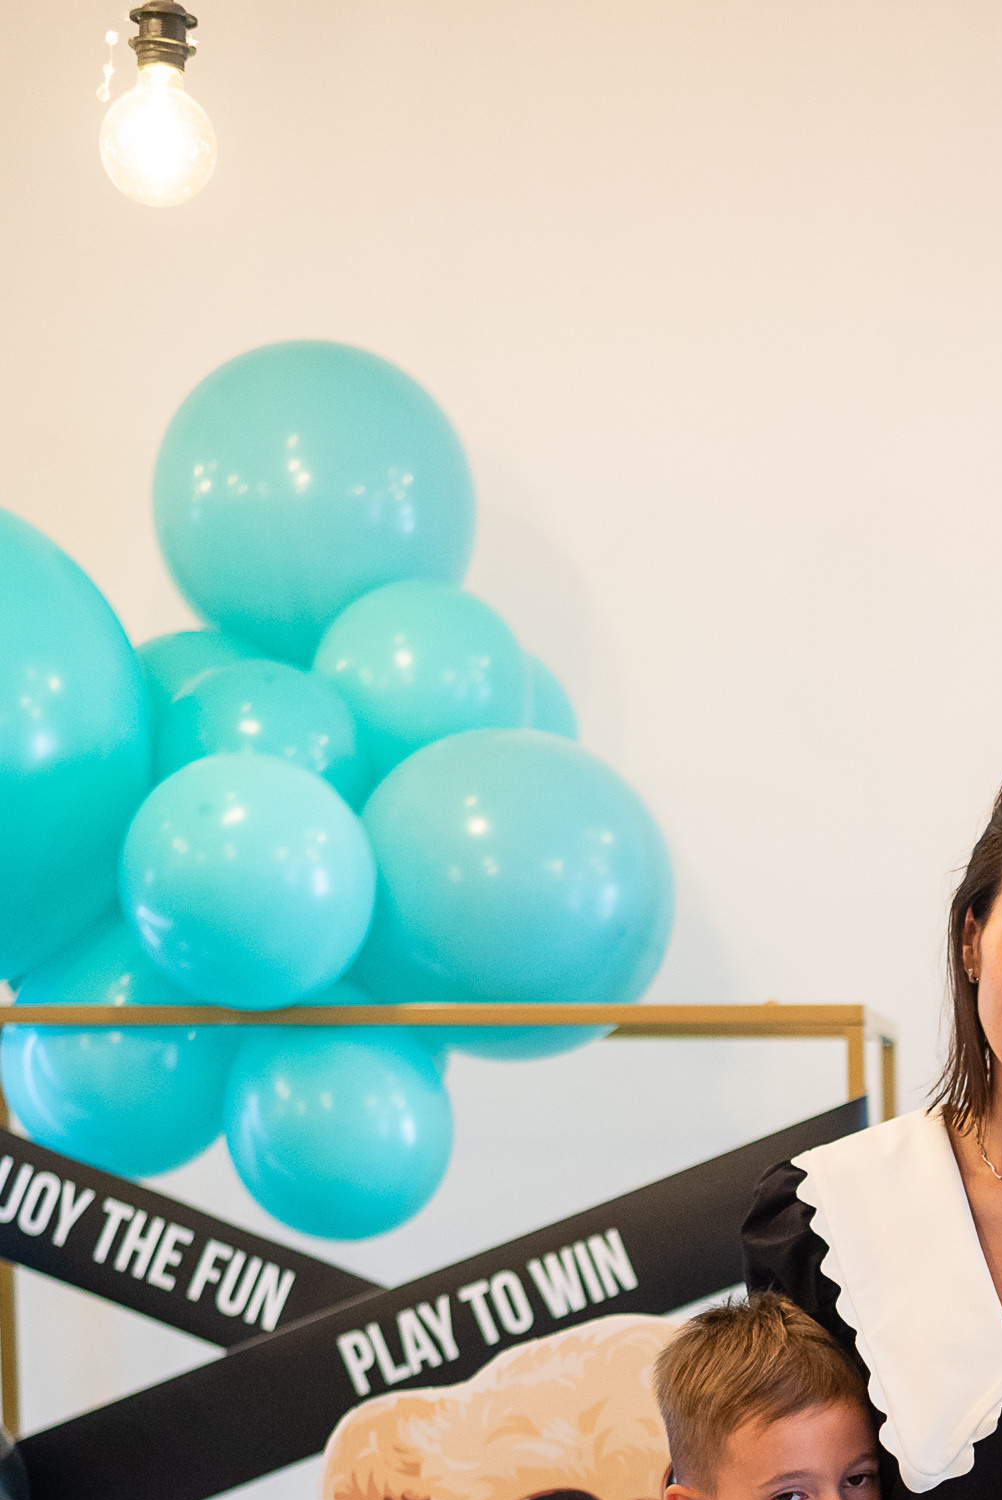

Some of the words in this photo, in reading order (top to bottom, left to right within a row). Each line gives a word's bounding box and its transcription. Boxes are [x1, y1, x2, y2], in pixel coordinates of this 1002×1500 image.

[92, 1196, 196, 1292] THE
[186, 1238, 297, 1333] FUN
[336, 1293, 460, 1398] PLAY
[457, 1269, 534, 1347] TO
[526, 1227, 639, 1320] WIN
